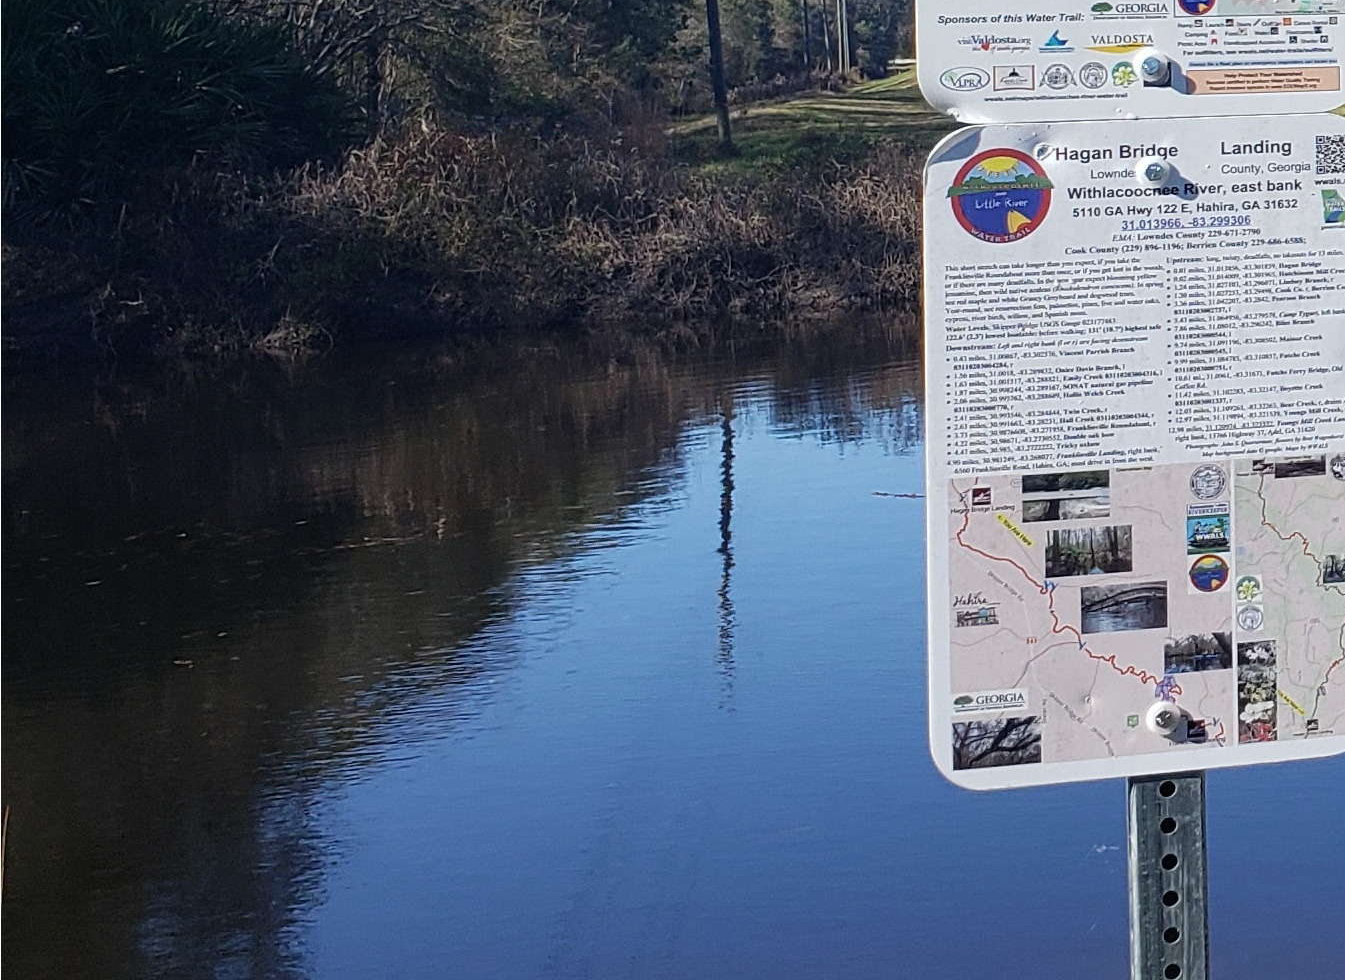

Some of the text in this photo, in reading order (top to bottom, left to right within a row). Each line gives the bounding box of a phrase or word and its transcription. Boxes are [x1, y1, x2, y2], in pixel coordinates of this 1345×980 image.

[1115, 3, 1169, 13] GEORGIA
[937, 16, 987, 24] Sponsors
[990, 14, 1001, 22] of
[1003, 14, 1022, 22] this
[1058, 13, 1084, 21] Trail:
[1091, 34, 1154, 44] VALDOSTA
[1056, 140, 1292, 163] Hagan Bridge Landing
[1091, 162, 1311, 179] Lownde County, Georgia
[1068, 179, 1303, 199] Withlacoochee River, east bank
[975, 197, 1029, 209] Little River
[1072, 199, 1297, 217] 5110 GA Hwy 122 E, Hahira, GA 31632
[1187, 215, 1251, 227] -83.299306
[1175, 231, 1205, 239] County
[1207, 228, 1261, 237] 229-671-2790
[1088, 246, 1119, 254] County
[1121, 244, 1142, 252] (229)
[1144, 243, 1184, 251] 896-1196;
[1218, 240, 1248, 248] County
[1250, 237, 1306, 245] 229-686-6588;
[976, 693, 1024, 705] GEORGIA
